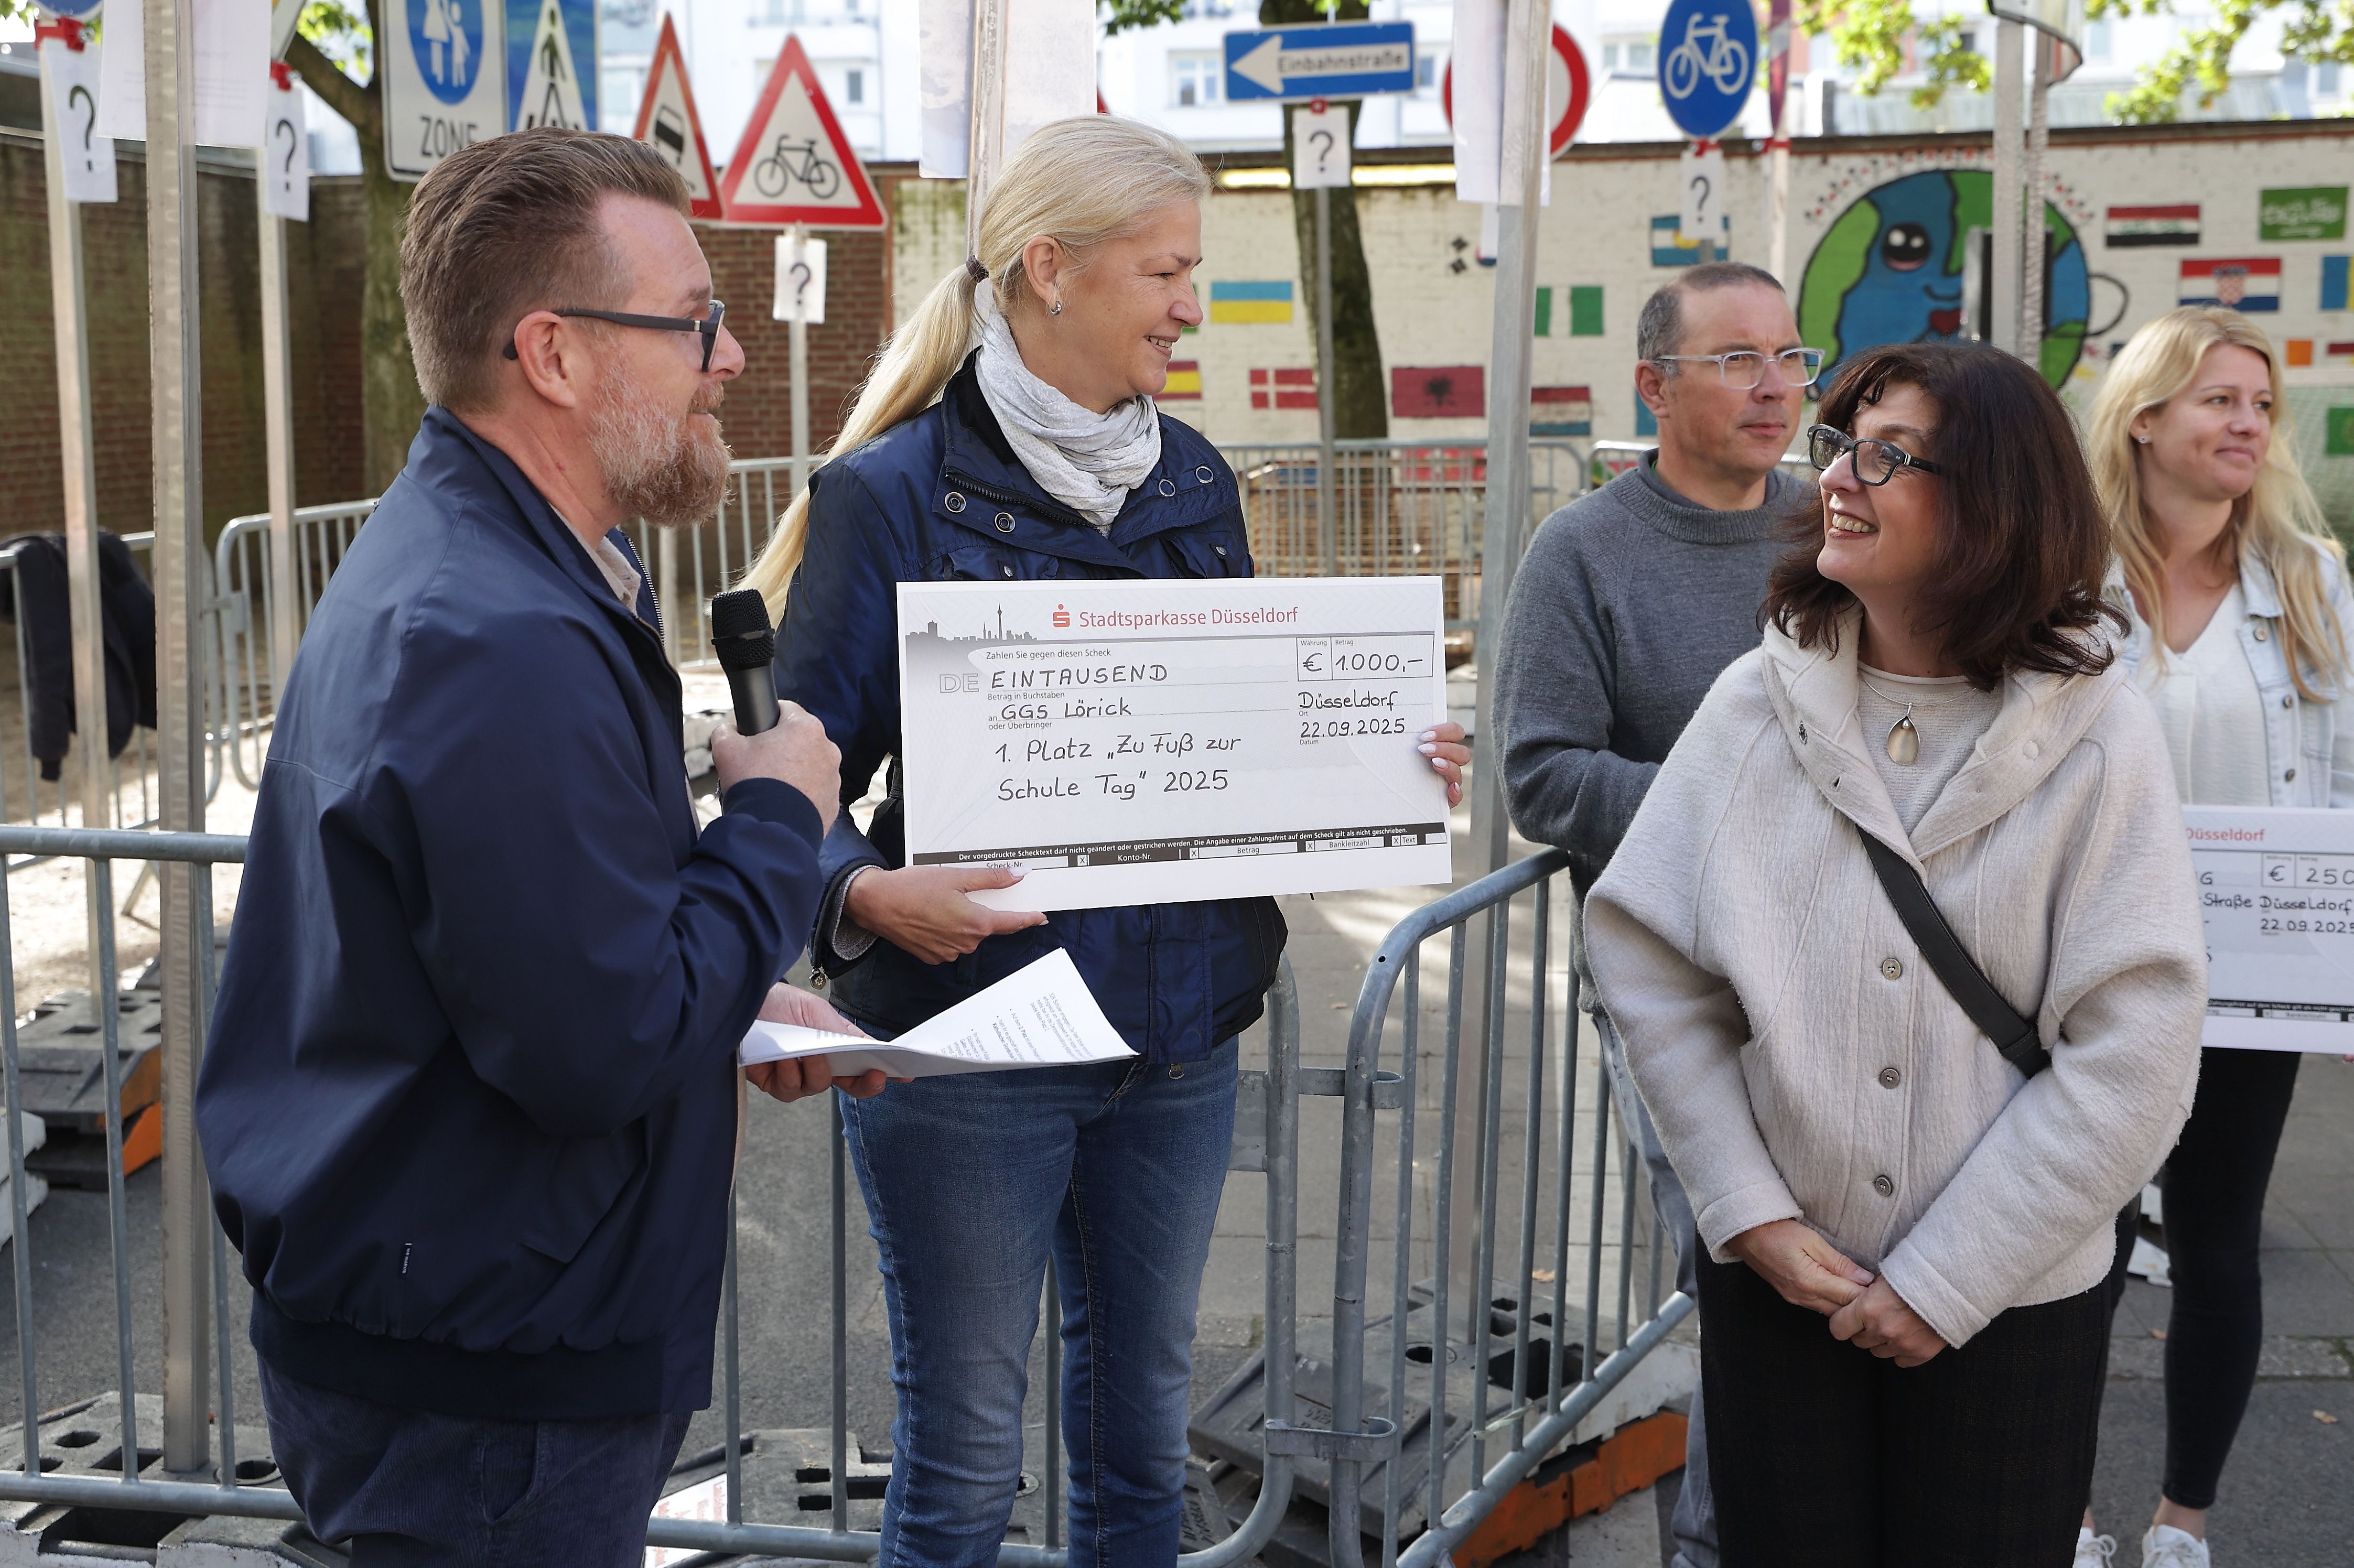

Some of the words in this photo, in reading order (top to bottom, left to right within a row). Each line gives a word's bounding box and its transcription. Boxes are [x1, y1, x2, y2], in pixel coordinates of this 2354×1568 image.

[1277, 51, 1403, 73] Einbahnstraße
[1079, 610, 1206, 629] Stadtsparkasse
[1212, 607, 1298, 624] Düsseldorf
[986, 651, 1014, 659] Zahlen
[1030, 651, 1055, 660] gegen
[1085, 648, 1111, 657] Scheck
[940, 673, 979, 693] DE
[991, 664, 1167, 688] EINTAUSEND
[1001, 704, 1048, 720] GGS
[1065, 697, 1131, 718] Lörick
[1298, 689, 1398, 711] Düsseldorf
[1008, 721, 1052, 730] Überbringer
[1300, 718, 1405, 738] 22.09.2025
[995, 743, 1011, 763] 1.
[1027, 737, 1092, 761] Platz
[1150, 732, 1193, 758] Fuß
[1206, 738, 1241, 751] zur
[998, 776, 1081, 802] Schule
[1163, 770, 1228, 793] 2025
[973, 851, 1016, 861] vorgedruckte
[1018, 849, 1053, 857] Schecktext
[1087, 845, 1115, 853] geändert
[1133, 841, 1166, 851] gestrichen
[1206, 838, 1229, 847] Angabe
[1248, 834, 1287, 844] Zahlungsfrist
[1335, 830, 1345, 839] gilt
[1372, 827, 1408, 836] geschrieben.
[2185, 827, 2265, 841] Düsseldorf
[1237, 847, 1259, 855] Betrag
[1329, 840, 1369, 849] Bankleitzahl
[1118, 853, 1152, 862] Konto-Nr.
[2259, 896, 2353, 916] Düsseldorf
